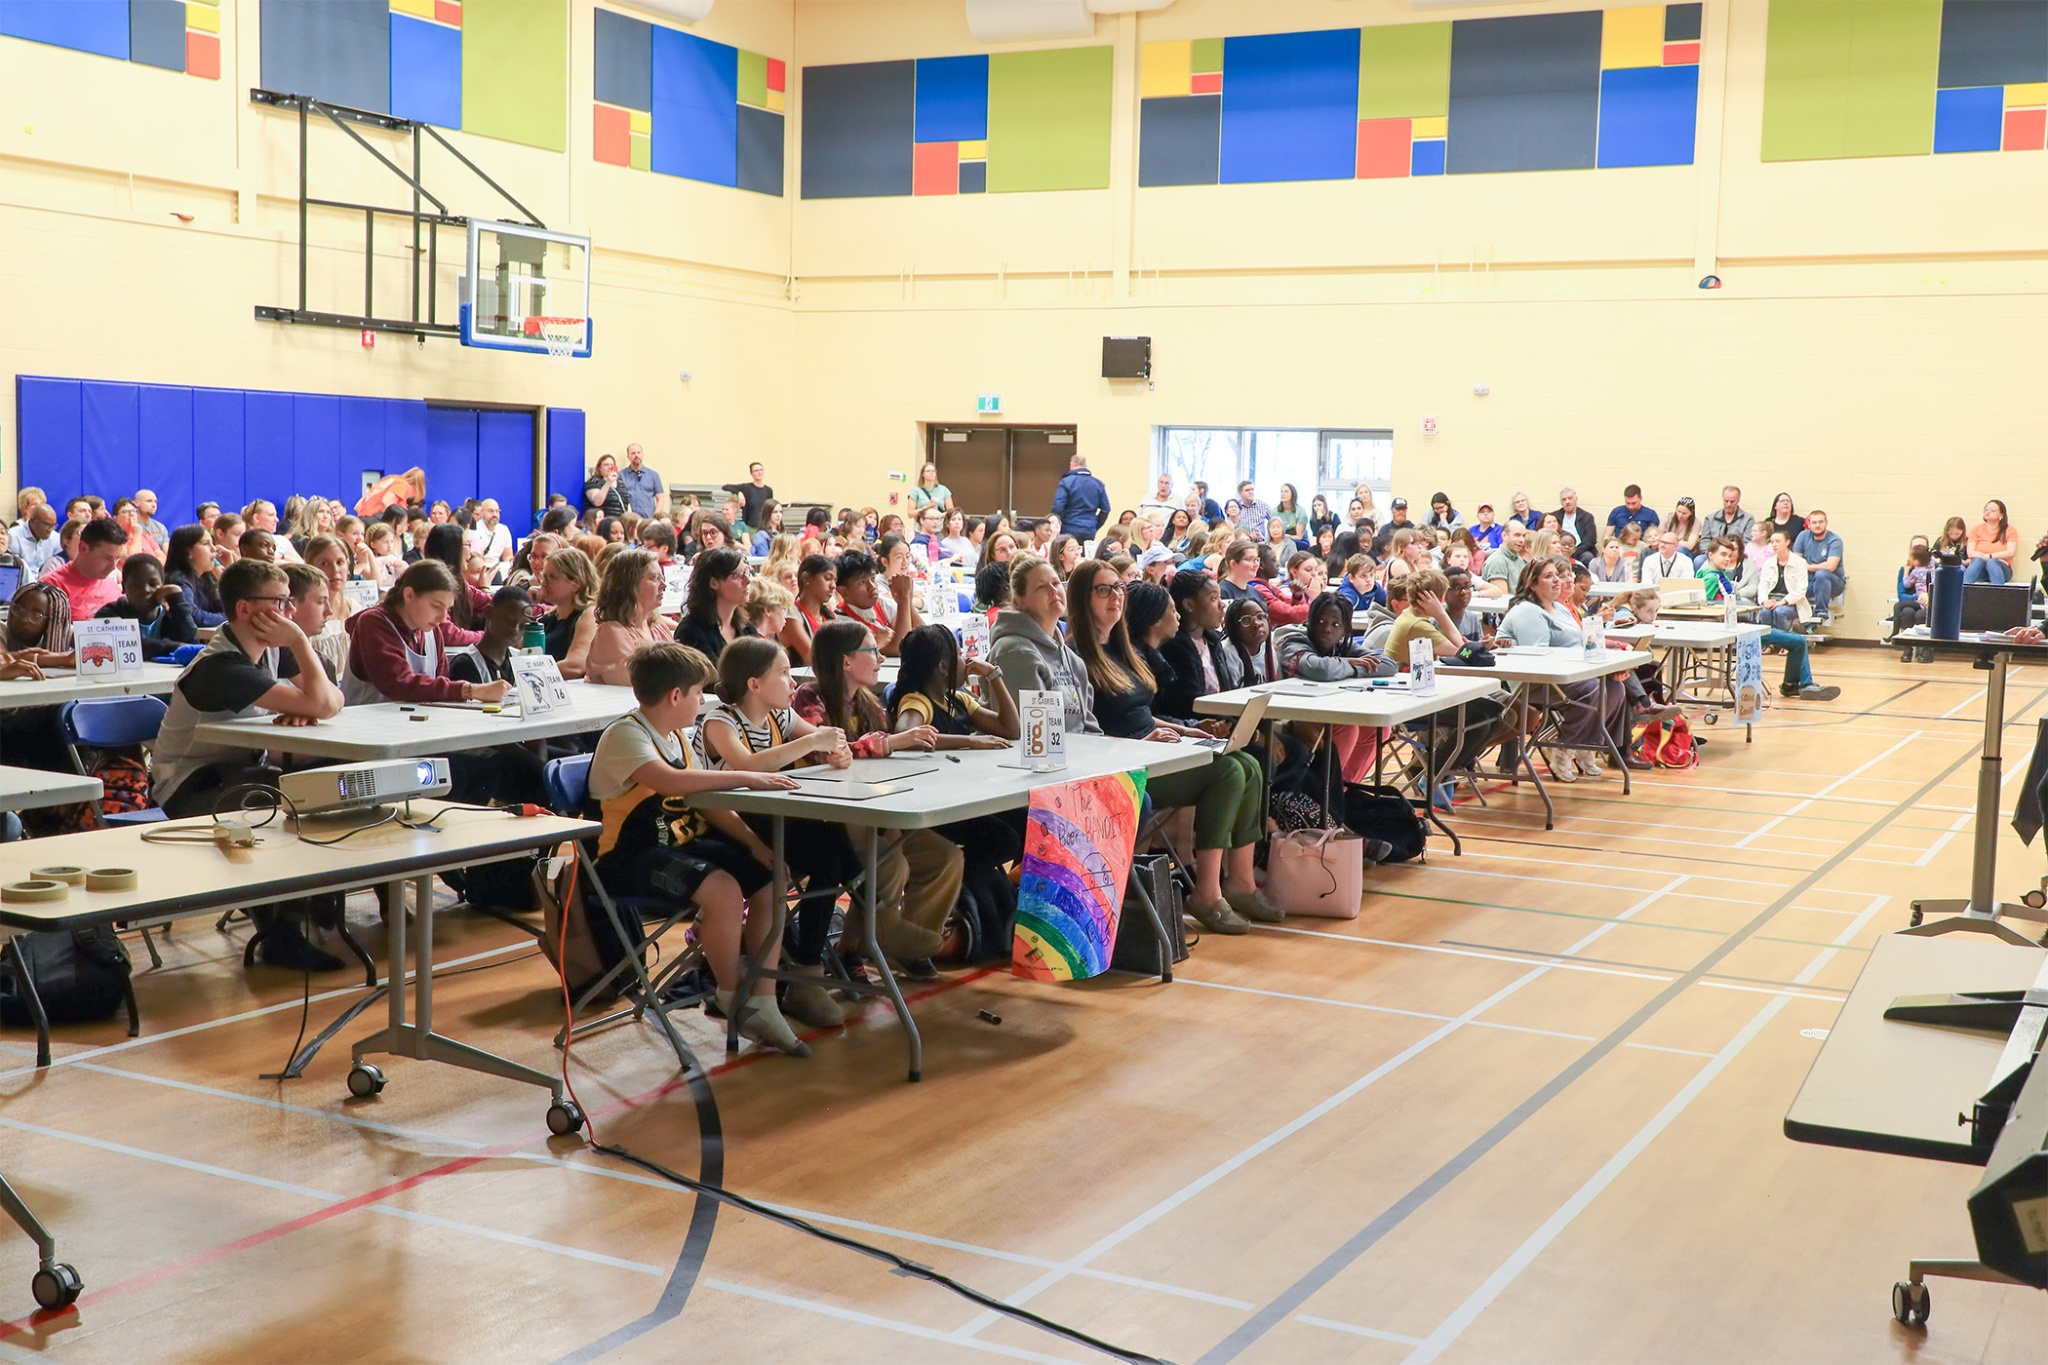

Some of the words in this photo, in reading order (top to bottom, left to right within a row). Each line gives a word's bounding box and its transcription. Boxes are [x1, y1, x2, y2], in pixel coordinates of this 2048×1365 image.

[982, 644, 988, 654] 15
[123, 652, 136, 663] 30
[547, 676, 561, 684] TEAM
[554, 688, 565, 700] 16
[1037, 697, 1055, 706] GABRIEL
[1048, 717, 1062, 727] TEAM
[1051, 732, 1060, 745] 32
[656, 814, 669, 847] ABRIEL
